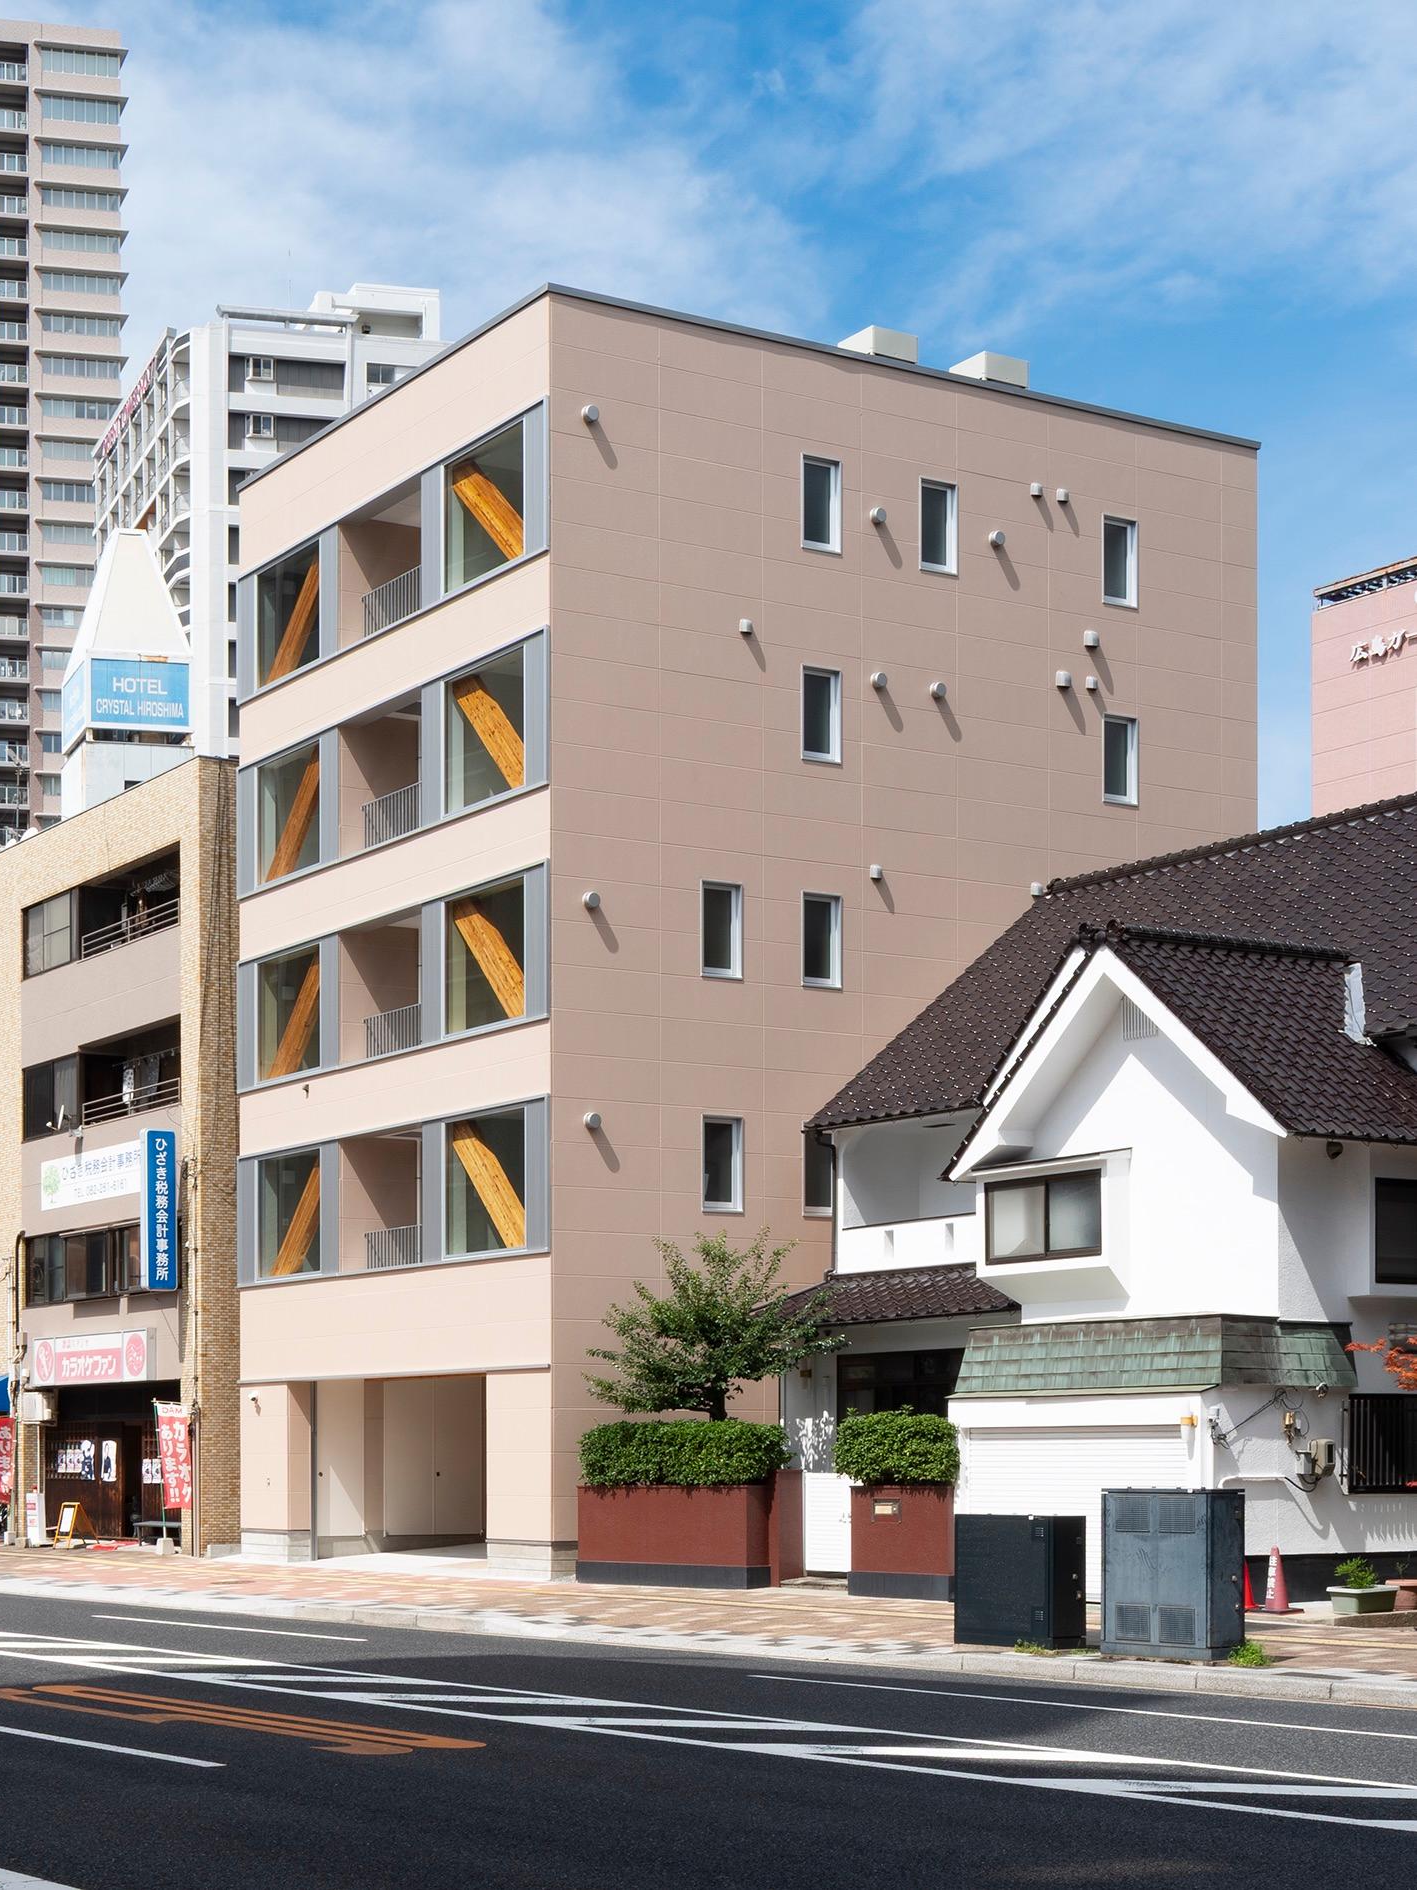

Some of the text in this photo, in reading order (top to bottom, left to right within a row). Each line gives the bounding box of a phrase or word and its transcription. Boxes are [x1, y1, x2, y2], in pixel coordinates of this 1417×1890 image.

[112, 676, 168, 695] HOTEL
[95, 698, 184, 719] CRYSTAL HIROSHIMA
[155, 1138, 169, 1281] ひざき税務会計事務所
[62, 1355, 116, 1378] カラオケファン
[161, 1406, 183, 1415] DAM
[173, 1421, 192, 1503] カラオケ
